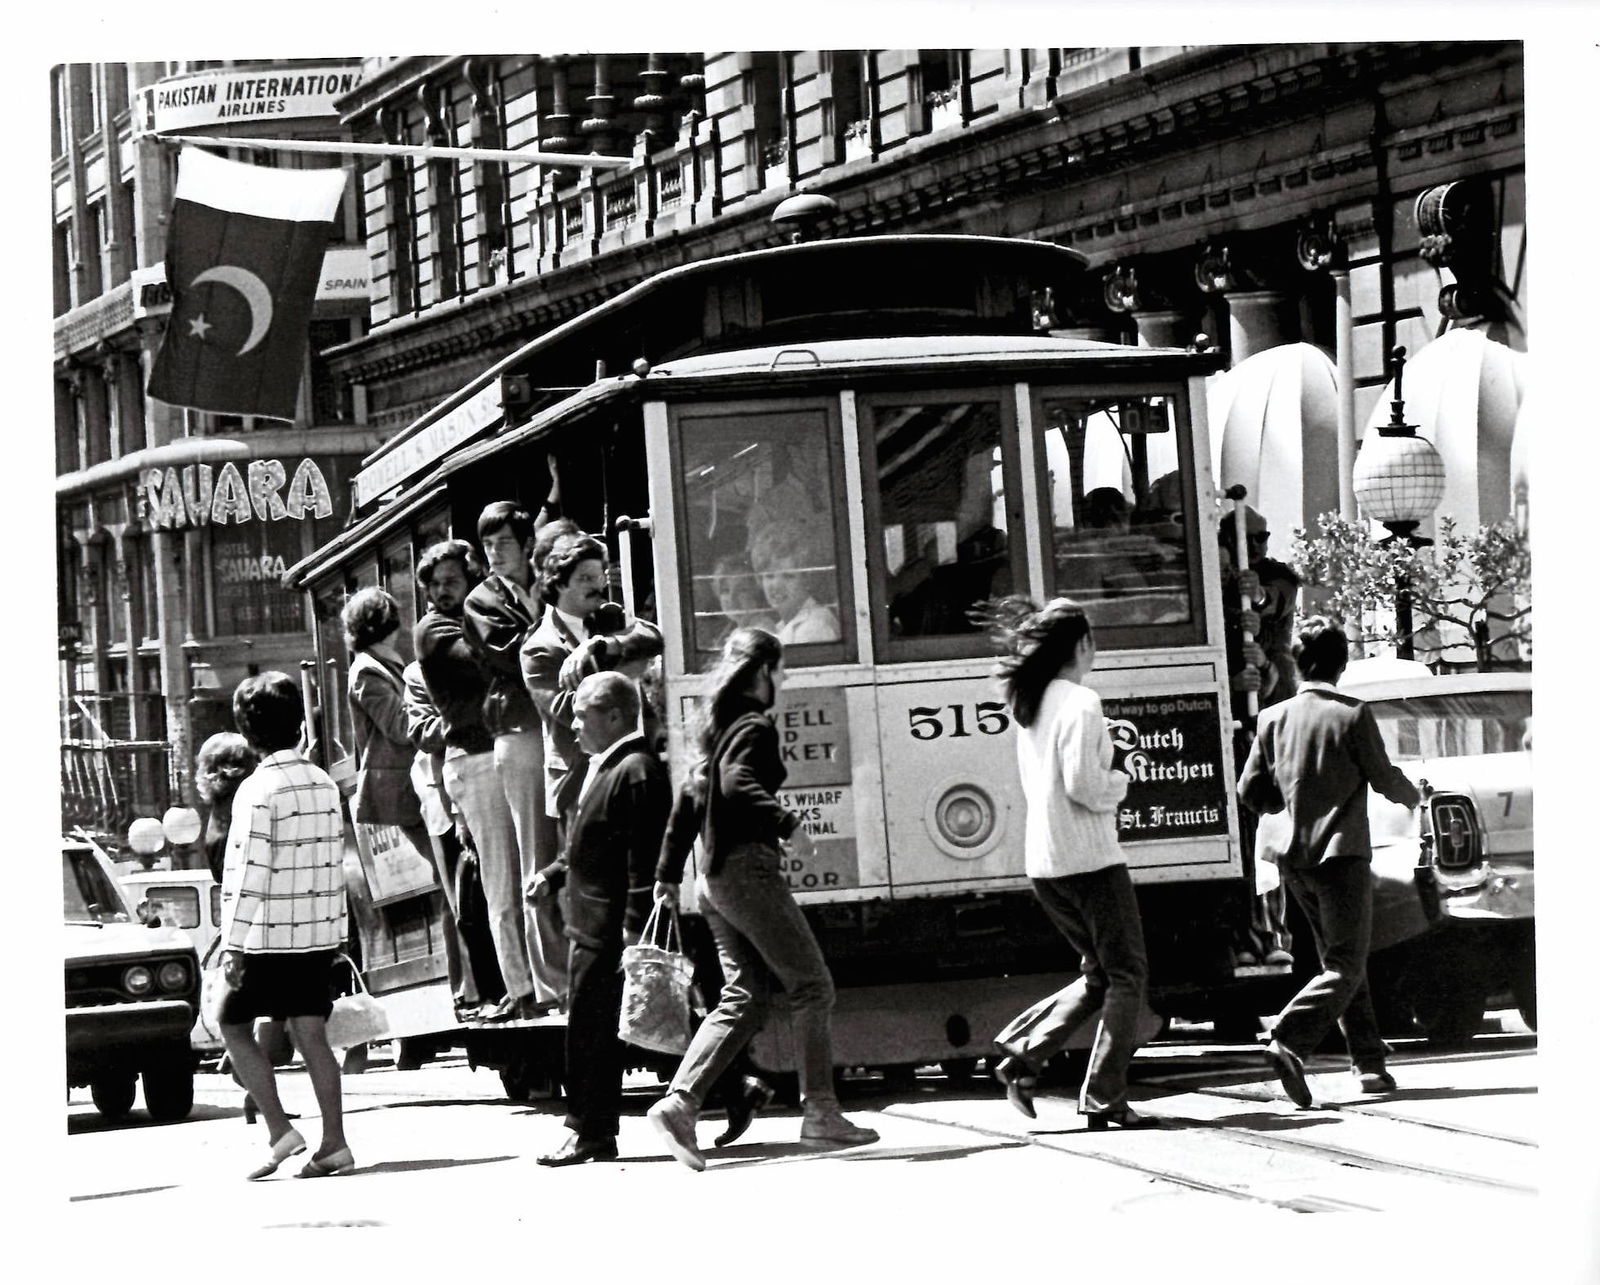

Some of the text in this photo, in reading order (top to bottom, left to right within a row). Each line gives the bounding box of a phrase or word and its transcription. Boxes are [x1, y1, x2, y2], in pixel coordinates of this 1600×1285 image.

[158, 84, 217, 109] PAKISTAN
[218, 100, 286, 118] AIRLINES
[325, 278, 367, 291] SPAIN
[1121, 705, 1144, 717] way
[1146, 703, 1158, 714] to
[1160, 703, 1176, 716] go
[1177, 699, 1212, 712] Dutch
[908, 702, 1010, 740] 515
[1107, 719, 1184, 750] Dutch
[782, 742, 835, 761] KET
[1124, 750, 1214, 783] Kitchen
[795, 791, 842, 806] WHARF
[1497, 791, 1514, 817] 7
[1119, 805, 1219, 832] St. Francis
[786, 872, 839, 888] LOR
